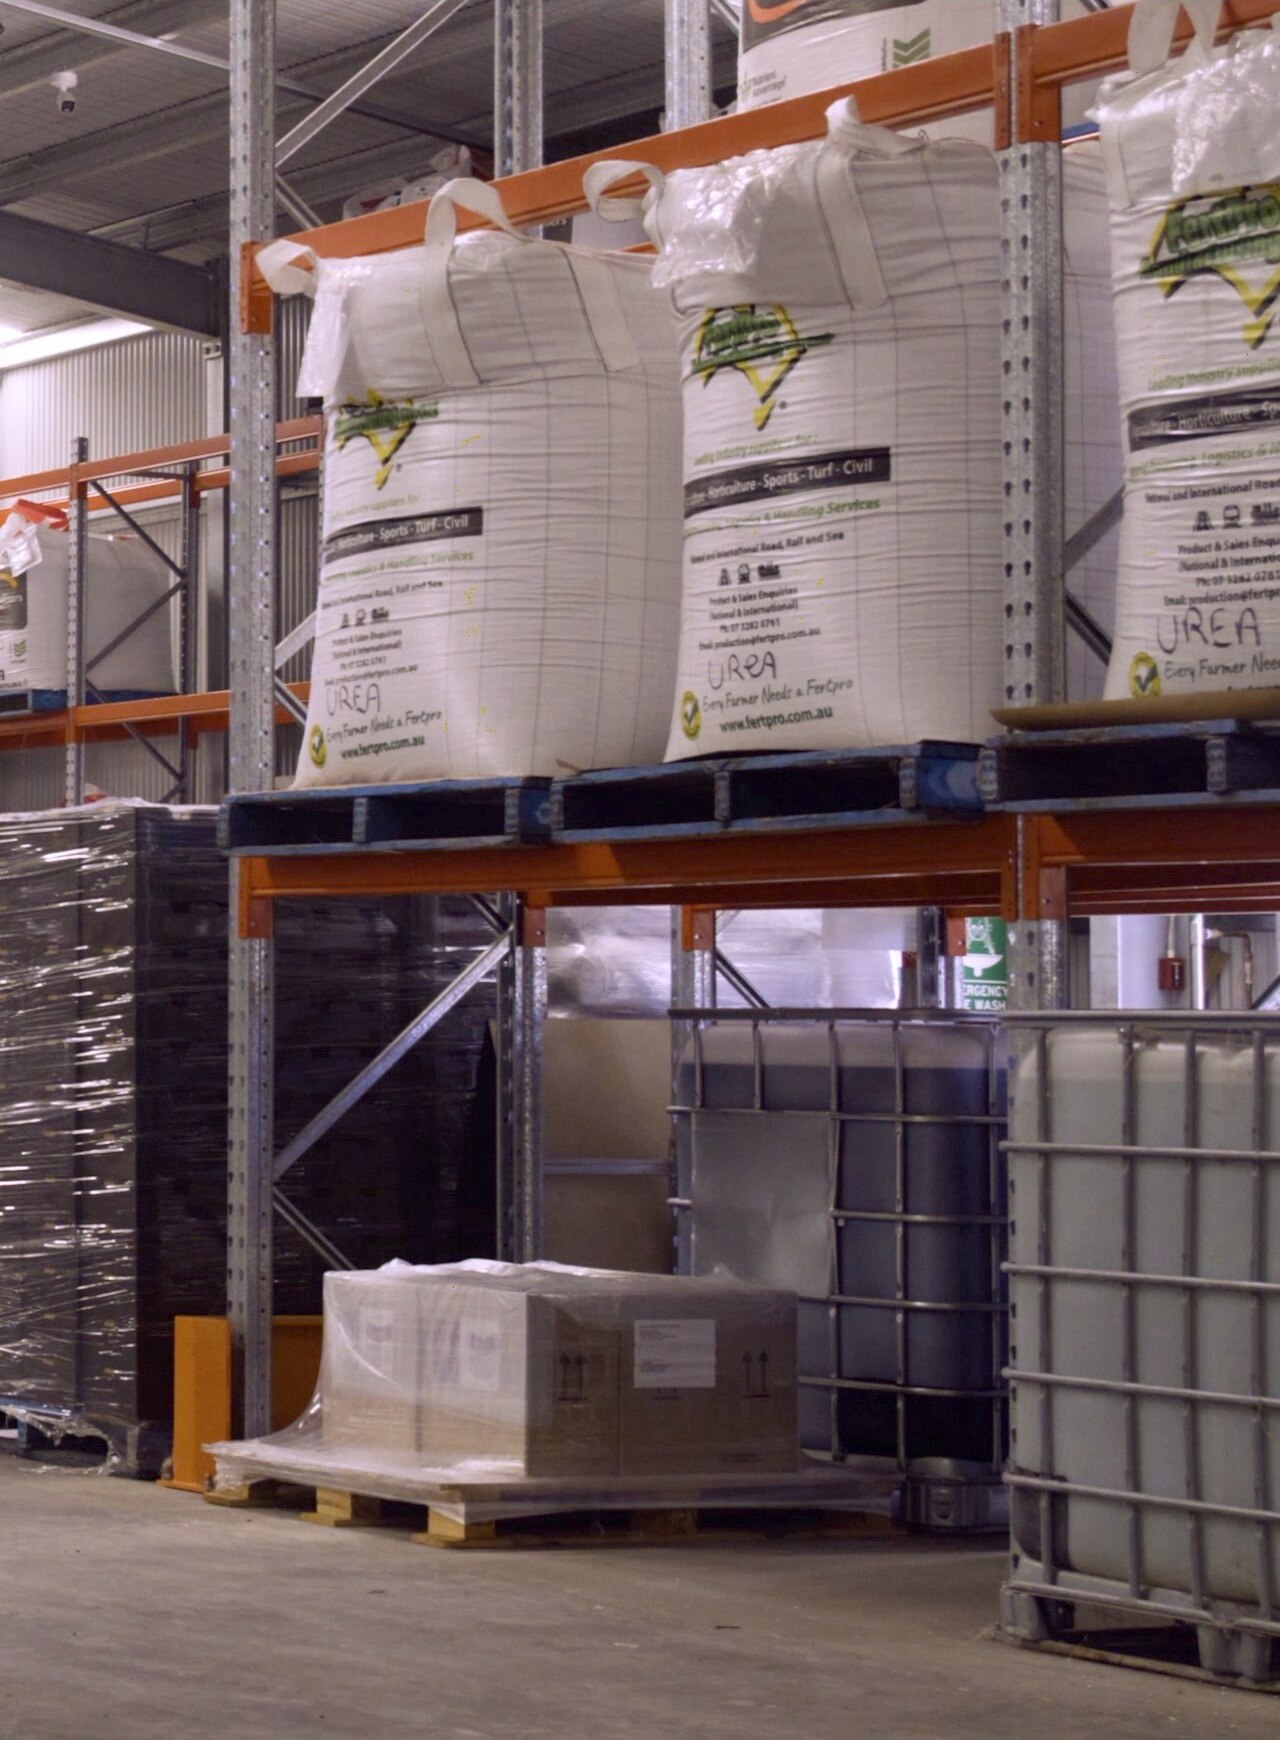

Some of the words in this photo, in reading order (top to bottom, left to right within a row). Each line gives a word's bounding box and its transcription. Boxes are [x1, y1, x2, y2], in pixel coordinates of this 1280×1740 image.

[1177, 406, 1252, 429] Horticulture
[708, 479, 756, 500] Horticulture
[762, 470, 800, 490] Sports
[806, 463, 833, 480] Turf
[842, 458, 873, 475] Civil
[826, 499, 881, 515] Services
[379, 522, 409, 542] Sports
[414, 518, 438, 534] Turf
[443, 513, 470, 530] Civil
[1223, 538, 1249, 552] Sales
[1156, 606, 1261, 655] UREA
[1198, 658, 1246, 677] Farmer
[326, 683, 382, 717] UREA
[725, 691, 759, 709] Farmer
[760, 683, 793, 704] Needs
[795, 687, 803, 697] a
[805, 678, 854, 696] Fertpro
[718, 705, 835, 733] www.fertpro.com.au
[974, 1000, 1007, 1011] WASH
